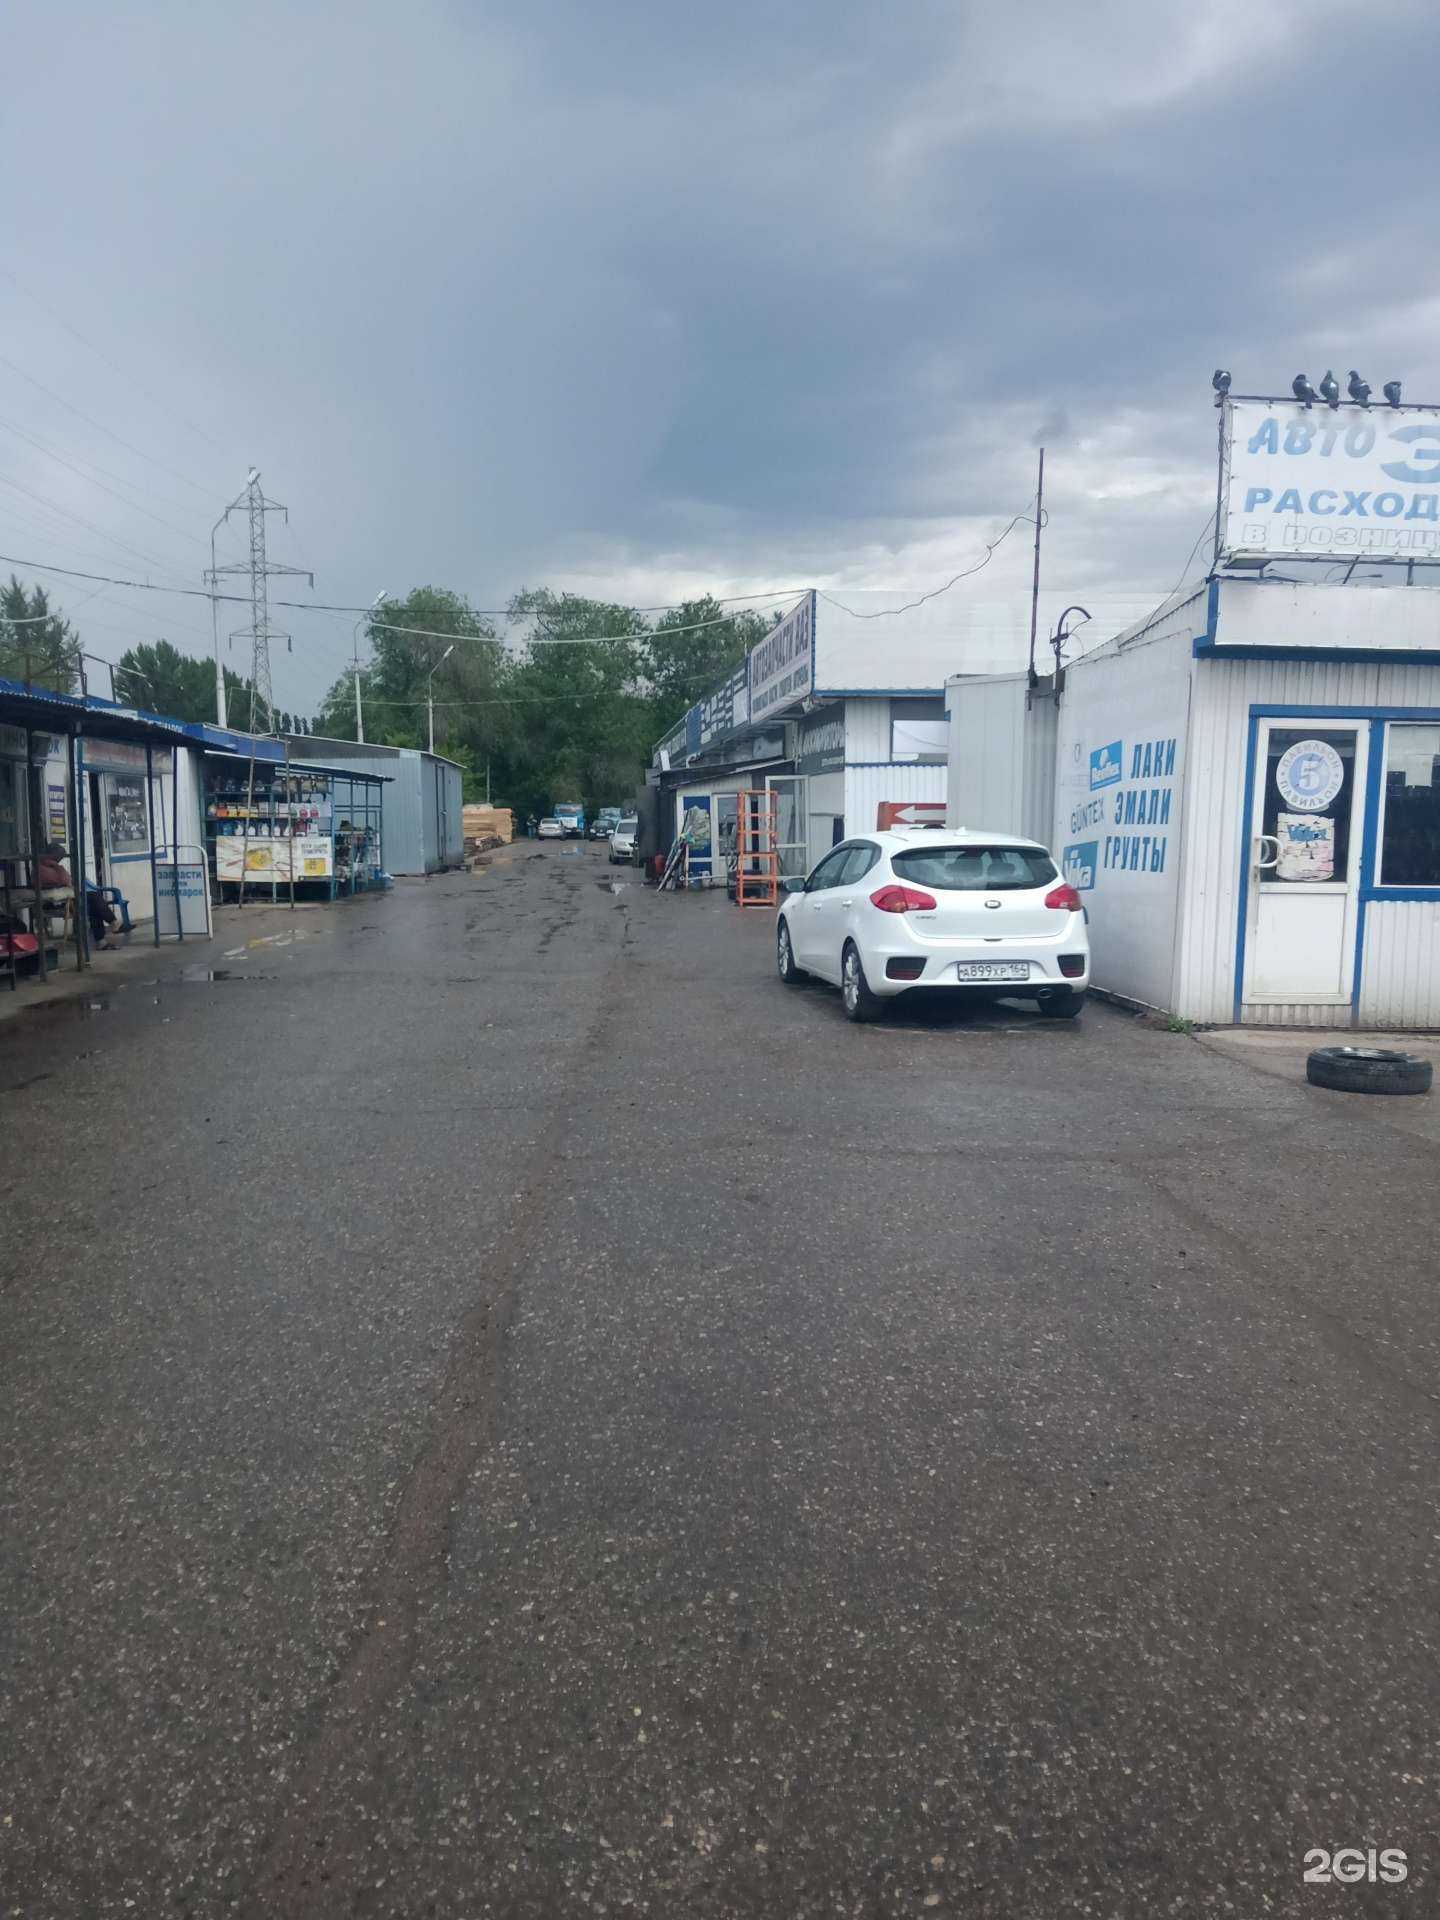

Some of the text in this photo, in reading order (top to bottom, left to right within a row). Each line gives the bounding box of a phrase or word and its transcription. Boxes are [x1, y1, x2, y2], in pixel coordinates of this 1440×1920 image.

[1247, 417, 1377, 459] АВТО
[1243, 487, 1440, 522] РАСХОД
[1131, 738, 1177, 779] ЛАКИ
[1299, 759, 1321, 790] 5
[1115, 788, 1172, 825] ЭМАЛИ
[1104, 835, 1167, 873] ГРУНТЫ
